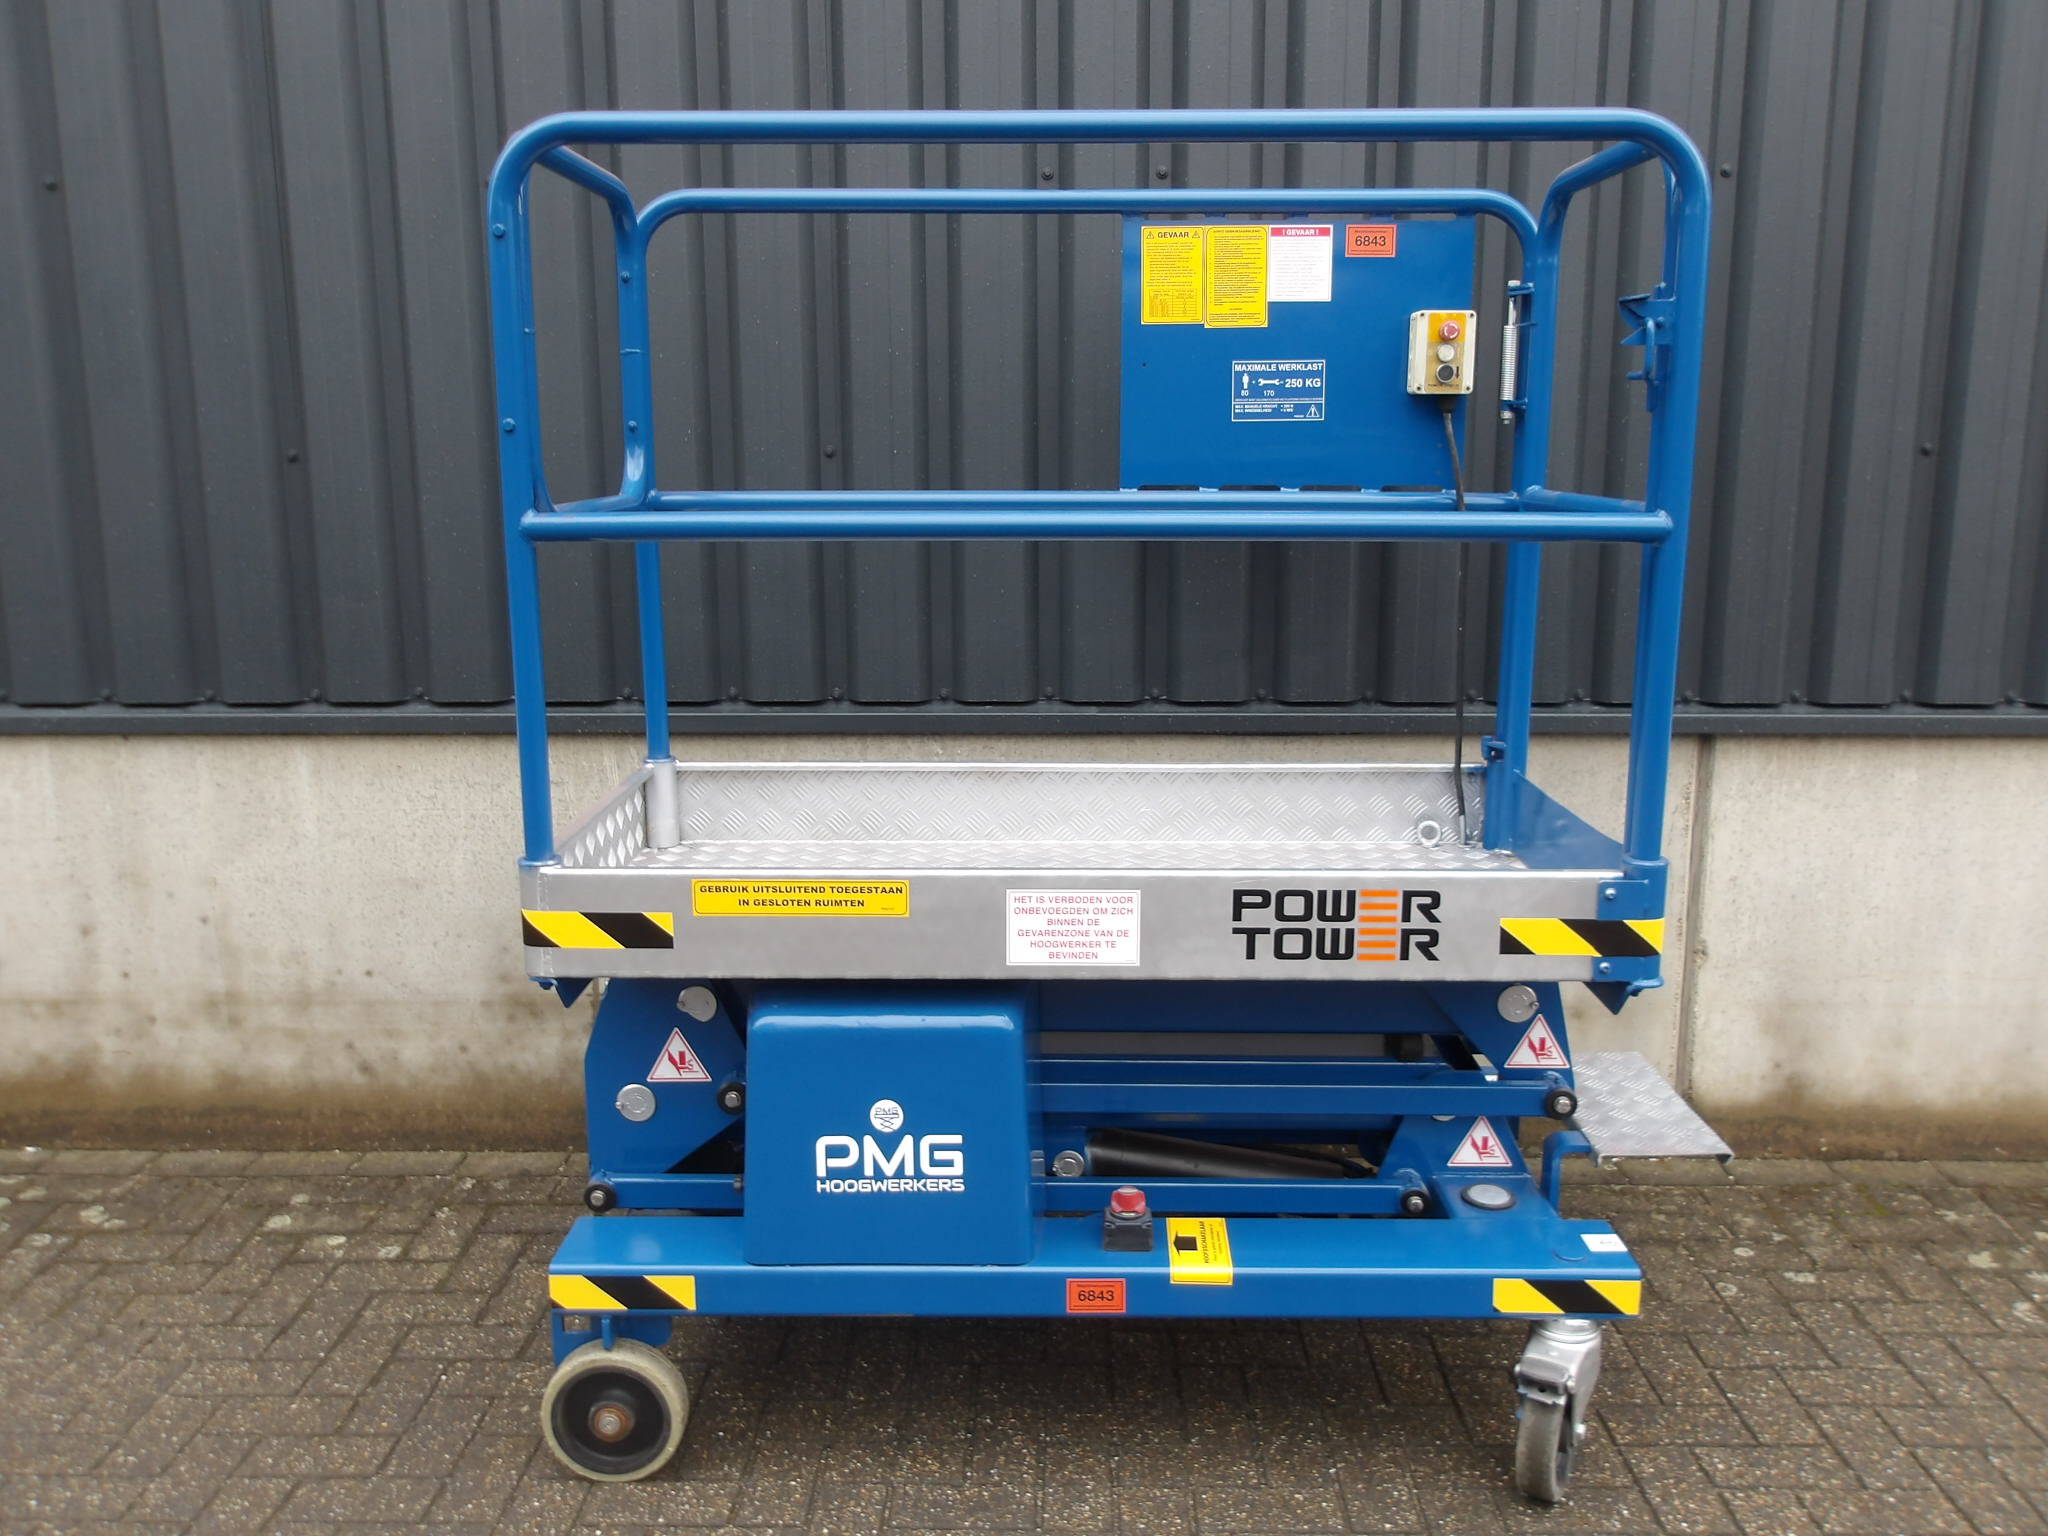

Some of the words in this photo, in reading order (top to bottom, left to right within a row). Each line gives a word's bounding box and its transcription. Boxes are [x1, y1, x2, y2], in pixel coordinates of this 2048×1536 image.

[1157, 231, 1190, 239] GEVAAR
[1354, 235, 1387, 247] 6843
[1234, 363, 1277, 372] MAXIMALE
[1278, 363, 1323, 372] WERKLAST
[1284, 378, 1303, 388] 250
[1305, 378, 1321, 388] KG
[1263, 389, 1275, 397] 170
[699, 885, 749, 894] GEBRUIK
[752, 885, 826, 894] UITSLUITEND
[829, 885, 904, 895] TOEGESTAAN
[738, 898, 750, 907] IN
[753, 898, 811, 907] GESLOTEN
[815, 899, 865, 907] RUIMTEN
[1013, 896, 1033, 904] HET
[1036, 896, 1045, 904] IS
[1048, 896, 1103, 904] VERBODEN
[1105, 896, 1134, 904] VOOR
[1232, 889, 1442, 923] POWER
[1013, 907, 1089, 915] ONBEVOEGDEN
[1092, 907, 1108, 915] OM
[1111, 907, 1134, 915] ZICH
[1047, 918, 1084, 926] BINNEN
[1087, 918, 1101, 926] DE
[1017, 929, 1091, 937] GEVARENZONE
[1094, 929, 1113, 937] VAN
[1116, 929, 1130, 937] DE
[1030, 940, 1102, 948] HOOGWERKER
[1104, 940, 1117, 948] TE
[1231, 927, 1440, 961] TOWER
[1048, 951, 1098, 960] BEVINDEN
[875, 1106, 899, 1115] PMG
[815, 1134, 964, 1177] PMG
[816, 1178, 966, 1193] HOOGWERKERS
[1078, 1290, 1115, 1302] 6843
